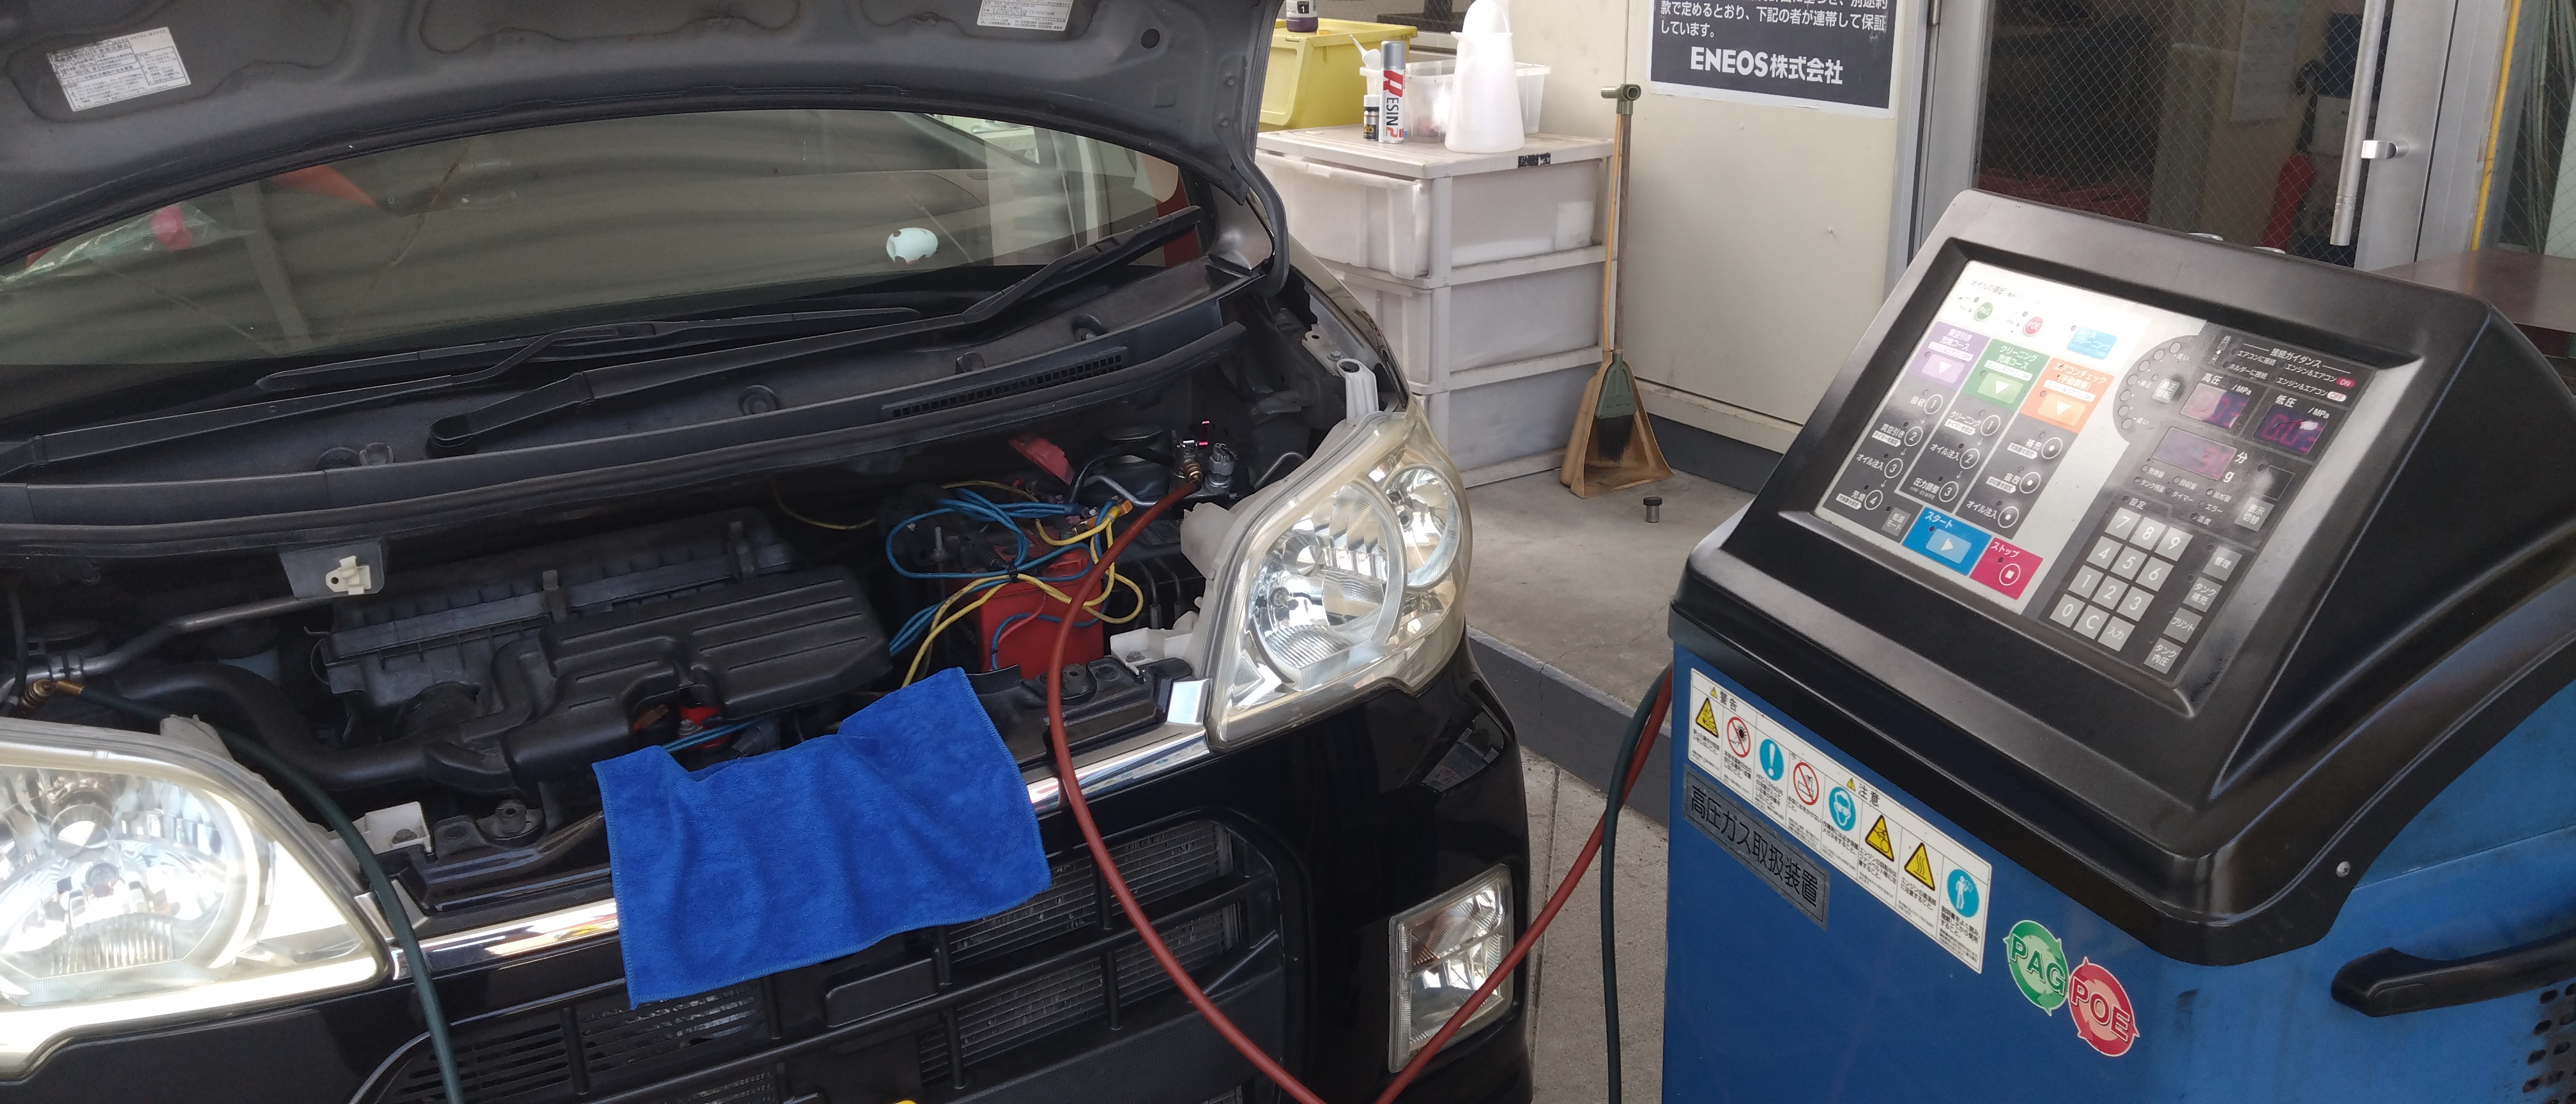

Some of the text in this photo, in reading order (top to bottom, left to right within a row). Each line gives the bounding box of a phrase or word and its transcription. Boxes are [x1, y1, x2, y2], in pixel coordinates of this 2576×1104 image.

[1661, 20, 1715, 38] しています。
[1690, 46, 1843, 84] ENEOS株式会社
[1978, 305, 1991, 316] PAG
[2027, 321, 2042, 331] POE
[1948, 328, 1973, 342] 真空引き
[1999, 346, 2039, 362] クリーニング
[2237, 350, 2276, 366] エアコンに接続
[2270, 348, 2323, 368] 接続ガイダンス
[2053, 362, 2108, 384] エアコンチェック
[2202, 372, 2222, 385] 高圧
[2228, 364, 2269, 379] ホルダーに接続
[2340, 379, 2351, 387] ON
[2156, 390, 2171, 400] 回転
[2274, 394, 2297, 408] 低圧
[2330, 392, 2344, 401] OFF
[1950, 410, 1982, 427] クリーニング
[1880, 424, 1905, 438] 真空引き
[1930, 443, 1959, 461] オイル注入
[2234, 452, 2248, 464] 分
[1857, 454, 1884, 470] オイル注入
[2223, 471, 2235, 483] g
[1913, 478, 1940, 494] 圧力調整
[2128, 497, 2147, 510] 設定
[2172, 491, 2194, 502] タイマー
[1966, 500, 1997, 519] オイル注入
[2205, 503, 2223, 513] エラー
[2248, 503, 2266, 516] 表示
[1887, 519, 1903, 530] モード
[1925, 511, 1953, 529] スタート
[2116, 516, 2132, 529] 7
[2242, 512, 2260, 525] 切替
[2142, 526, 2154, 540] 8
[1991, 542, 2020, 558] ストップ
[2168, 537, 2181, 549] 9
[2098, 547, 2112, 560] 4
[2122, 556, 2136, 569] 5
[2214, 556, 2232, 569] 管理
[2082, 574, 2092, 588] 1
[2149, 568, 2161, 581] 6
[2103, 585, 2117, 600] 2
[2193, 583, 2217, 596] タンク
[2129, 596, 2142, 611] 3
[2191, 592, 2209, 606] 補充
[2062, 603, 2074, 617] 0
[2086, 615, 2099, 629] C
[2171, 617, 2195, 631] プリント
[2106, 626, 2125, 640] 入力
[2154, 643, 2177, 658] タンク
[2151, 654, 2170, 667] 内圧
[1720, 691, 1737, 712] 警告
[1859, 783, 1880, 808] 注意
[1691, 785, 1818, 907] 高圧ガス取扱装置
[2011, 933, 2066, 996] PAG
[2071, 976, 2131, 1042] POE
